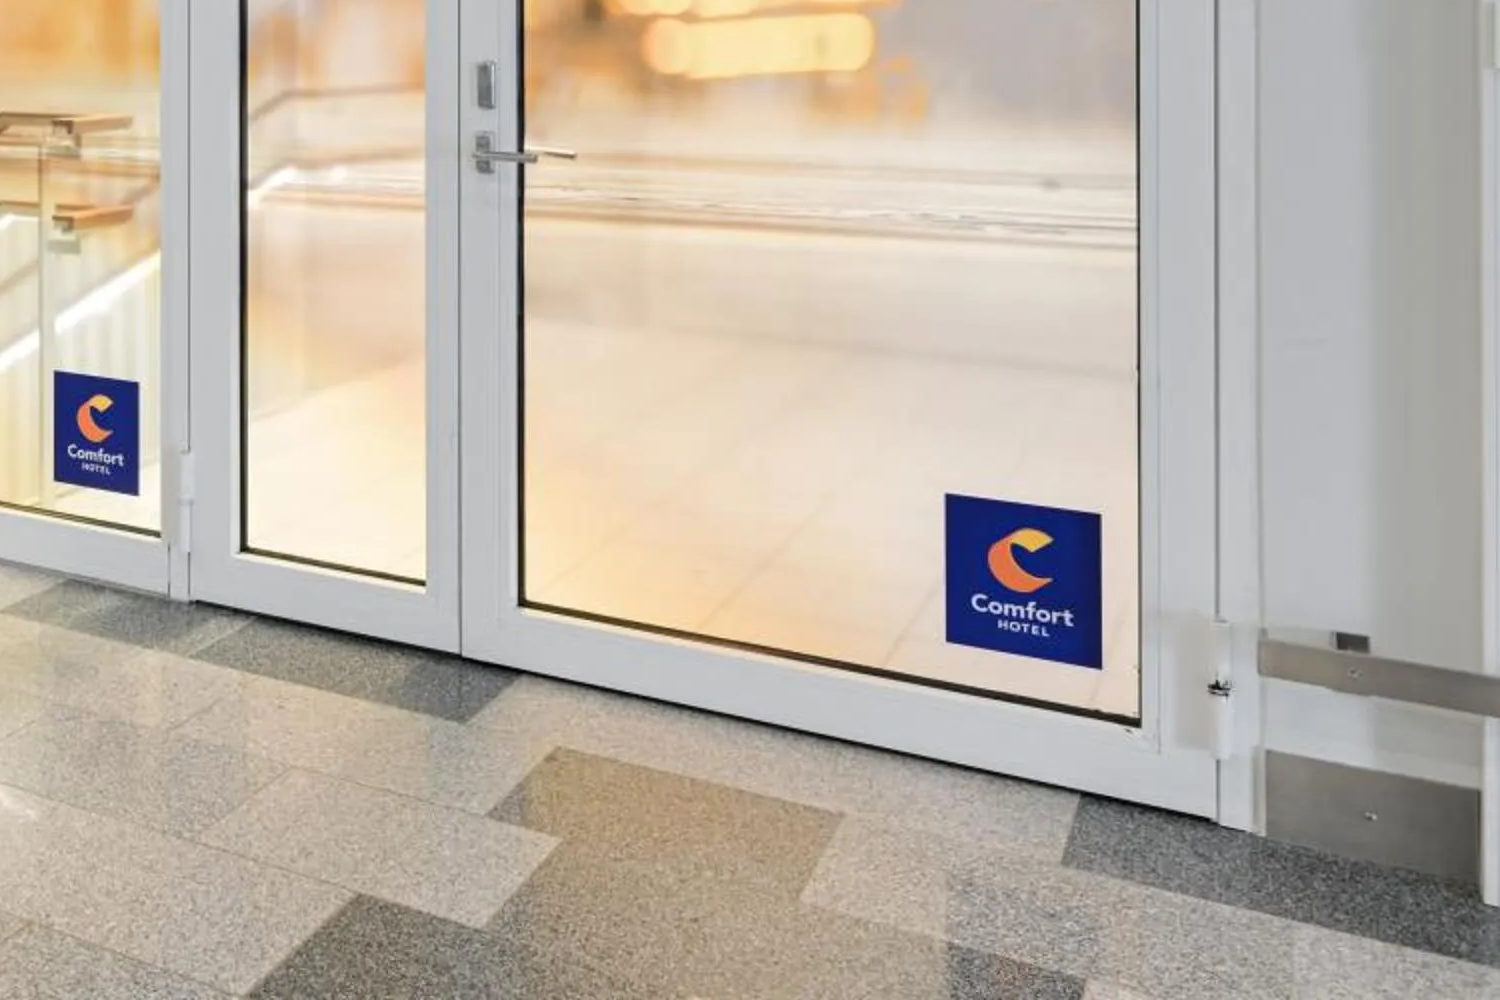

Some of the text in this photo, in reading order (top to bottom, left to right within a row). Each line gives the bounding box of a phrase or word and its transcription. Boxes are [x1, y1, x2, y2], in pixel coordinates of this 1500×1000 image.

[67, 443, 124, 467] Comfort
[81, 461, 111, 475] HOTEL
[970, 592, 1074, 628] Comfort
[997, 619, 1050, 638] HOTEL
